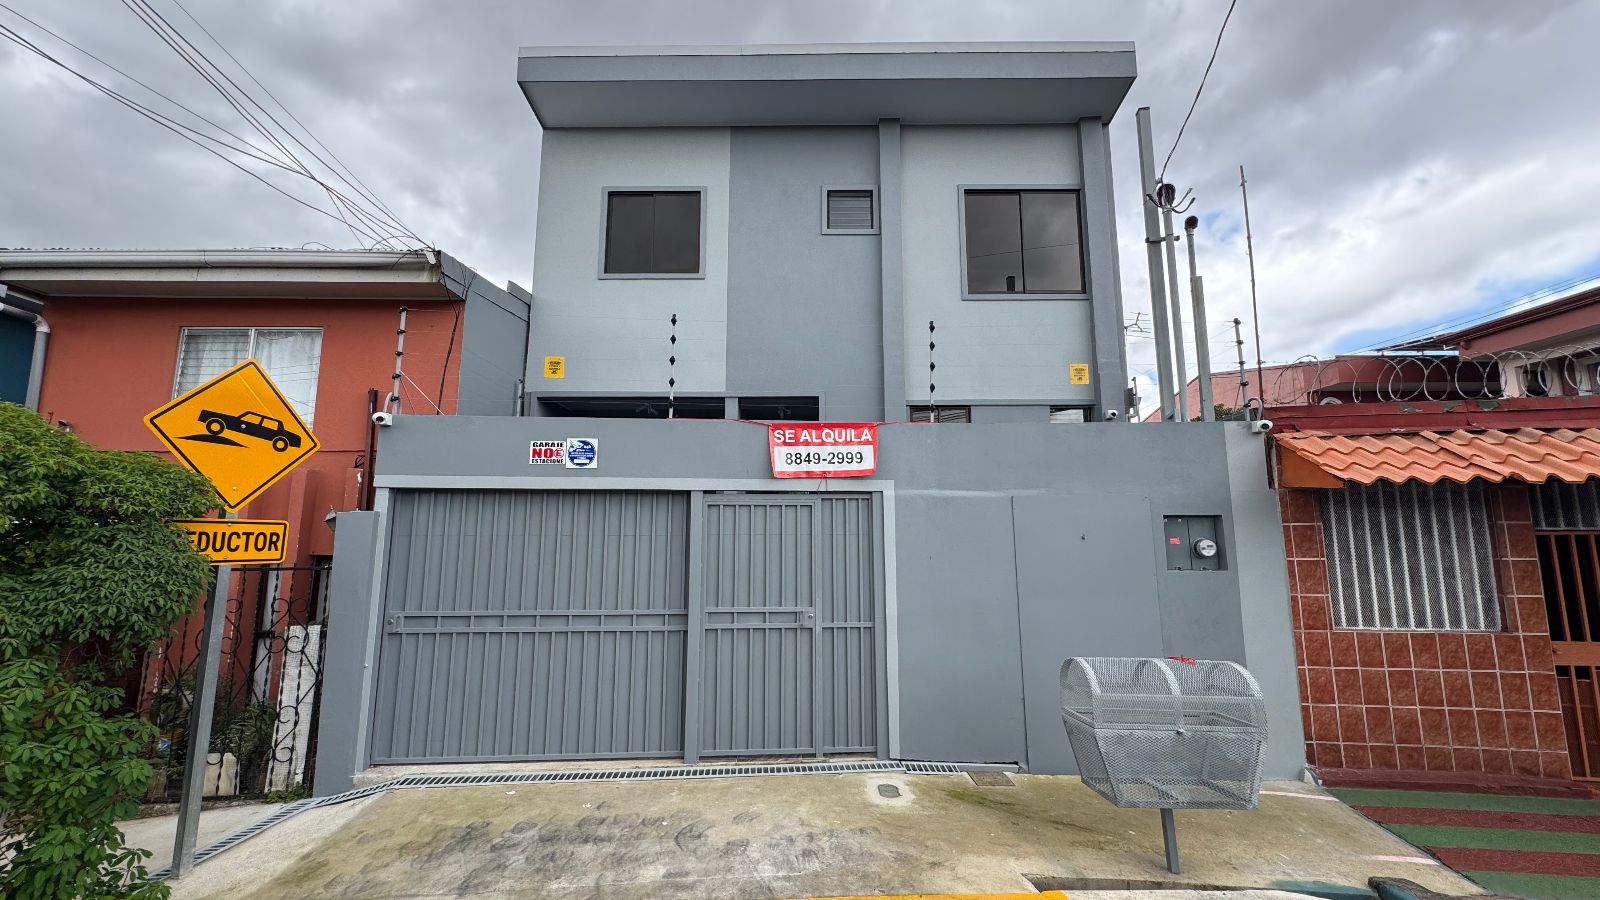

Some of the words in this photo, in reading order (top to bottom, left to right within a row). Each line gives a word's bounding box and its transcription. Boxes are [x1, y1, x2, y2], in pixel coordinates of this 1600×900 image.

[773, 429, 796, 443] SE
[799, 428, 873, 443] ALQUILA
[531, 447, 554, 459] NO
[785, 451, 864, 465] 8849-2999
